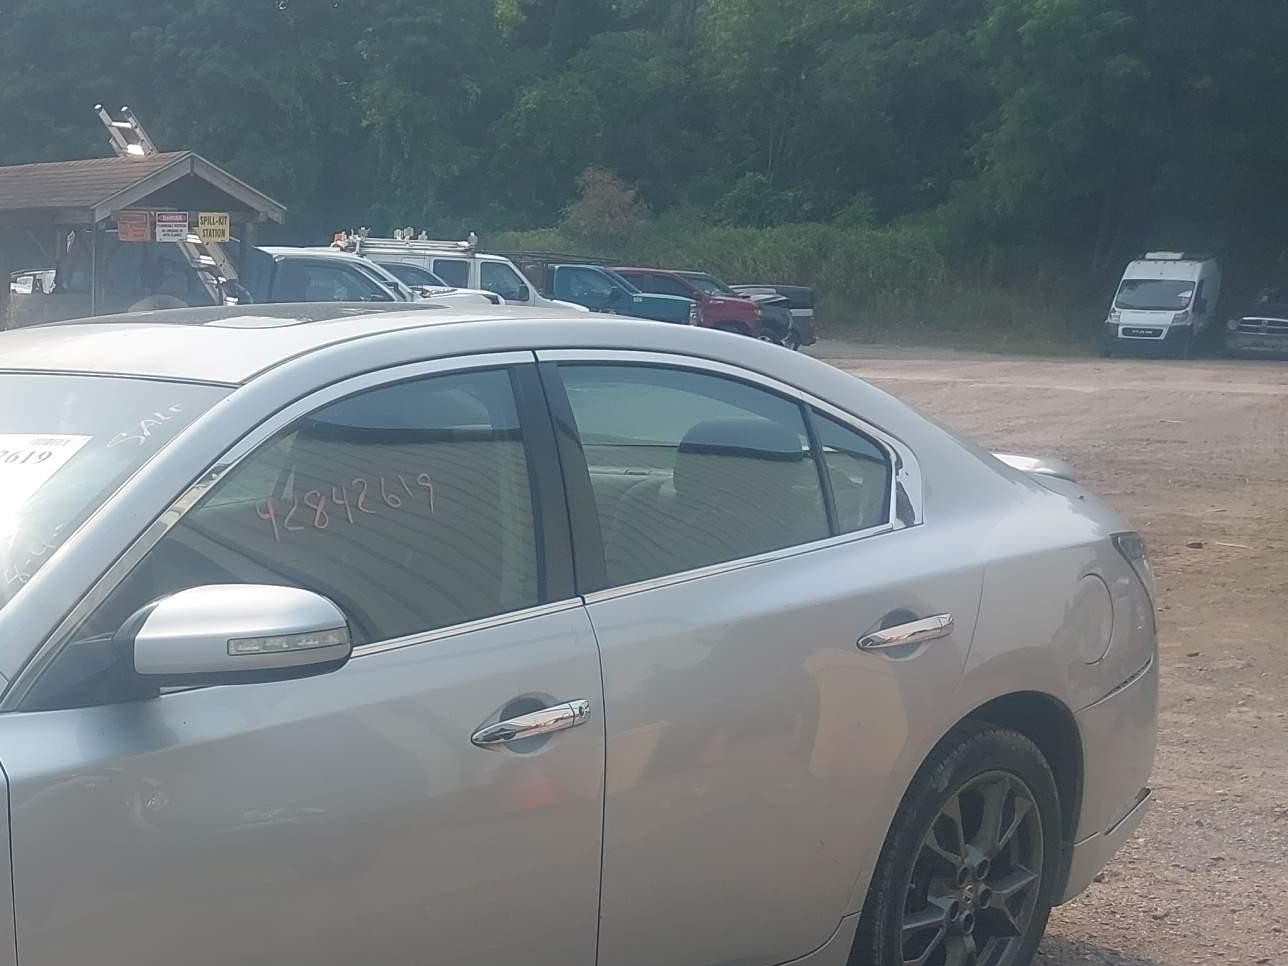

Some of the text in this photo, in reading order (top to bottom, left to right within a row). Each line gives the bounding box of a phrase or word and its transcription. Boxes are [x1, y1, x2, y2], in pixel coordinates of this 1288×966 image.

[200, 215, 228, 226] SPILL-KIT
[202, 228, 226, 239] STATION
[255, 472, 434, 541] 42842619
